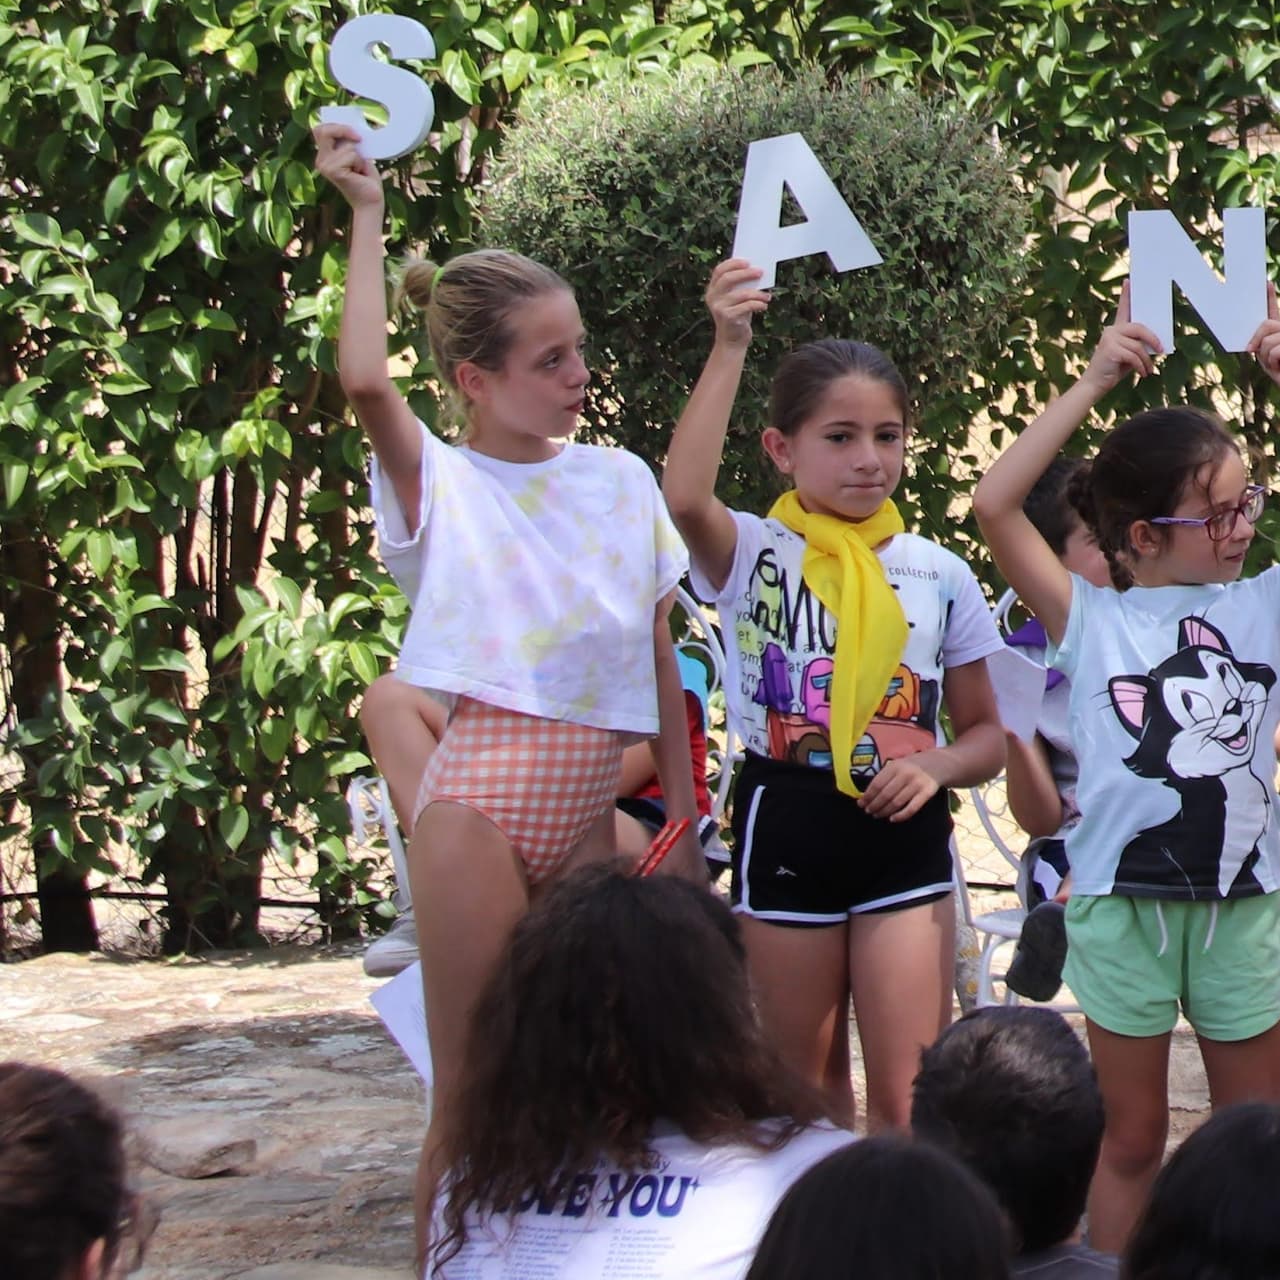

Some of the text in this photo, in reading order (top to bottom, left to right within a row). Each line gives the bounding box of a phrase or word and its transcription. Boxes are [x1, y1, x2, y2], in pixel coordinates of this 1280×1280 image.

[321, 13, 436, 160] S
[731, 132, 884, 290] A
[1128, 208, 1269, 355] N
[607, 1173, 693, 1218] YOU
